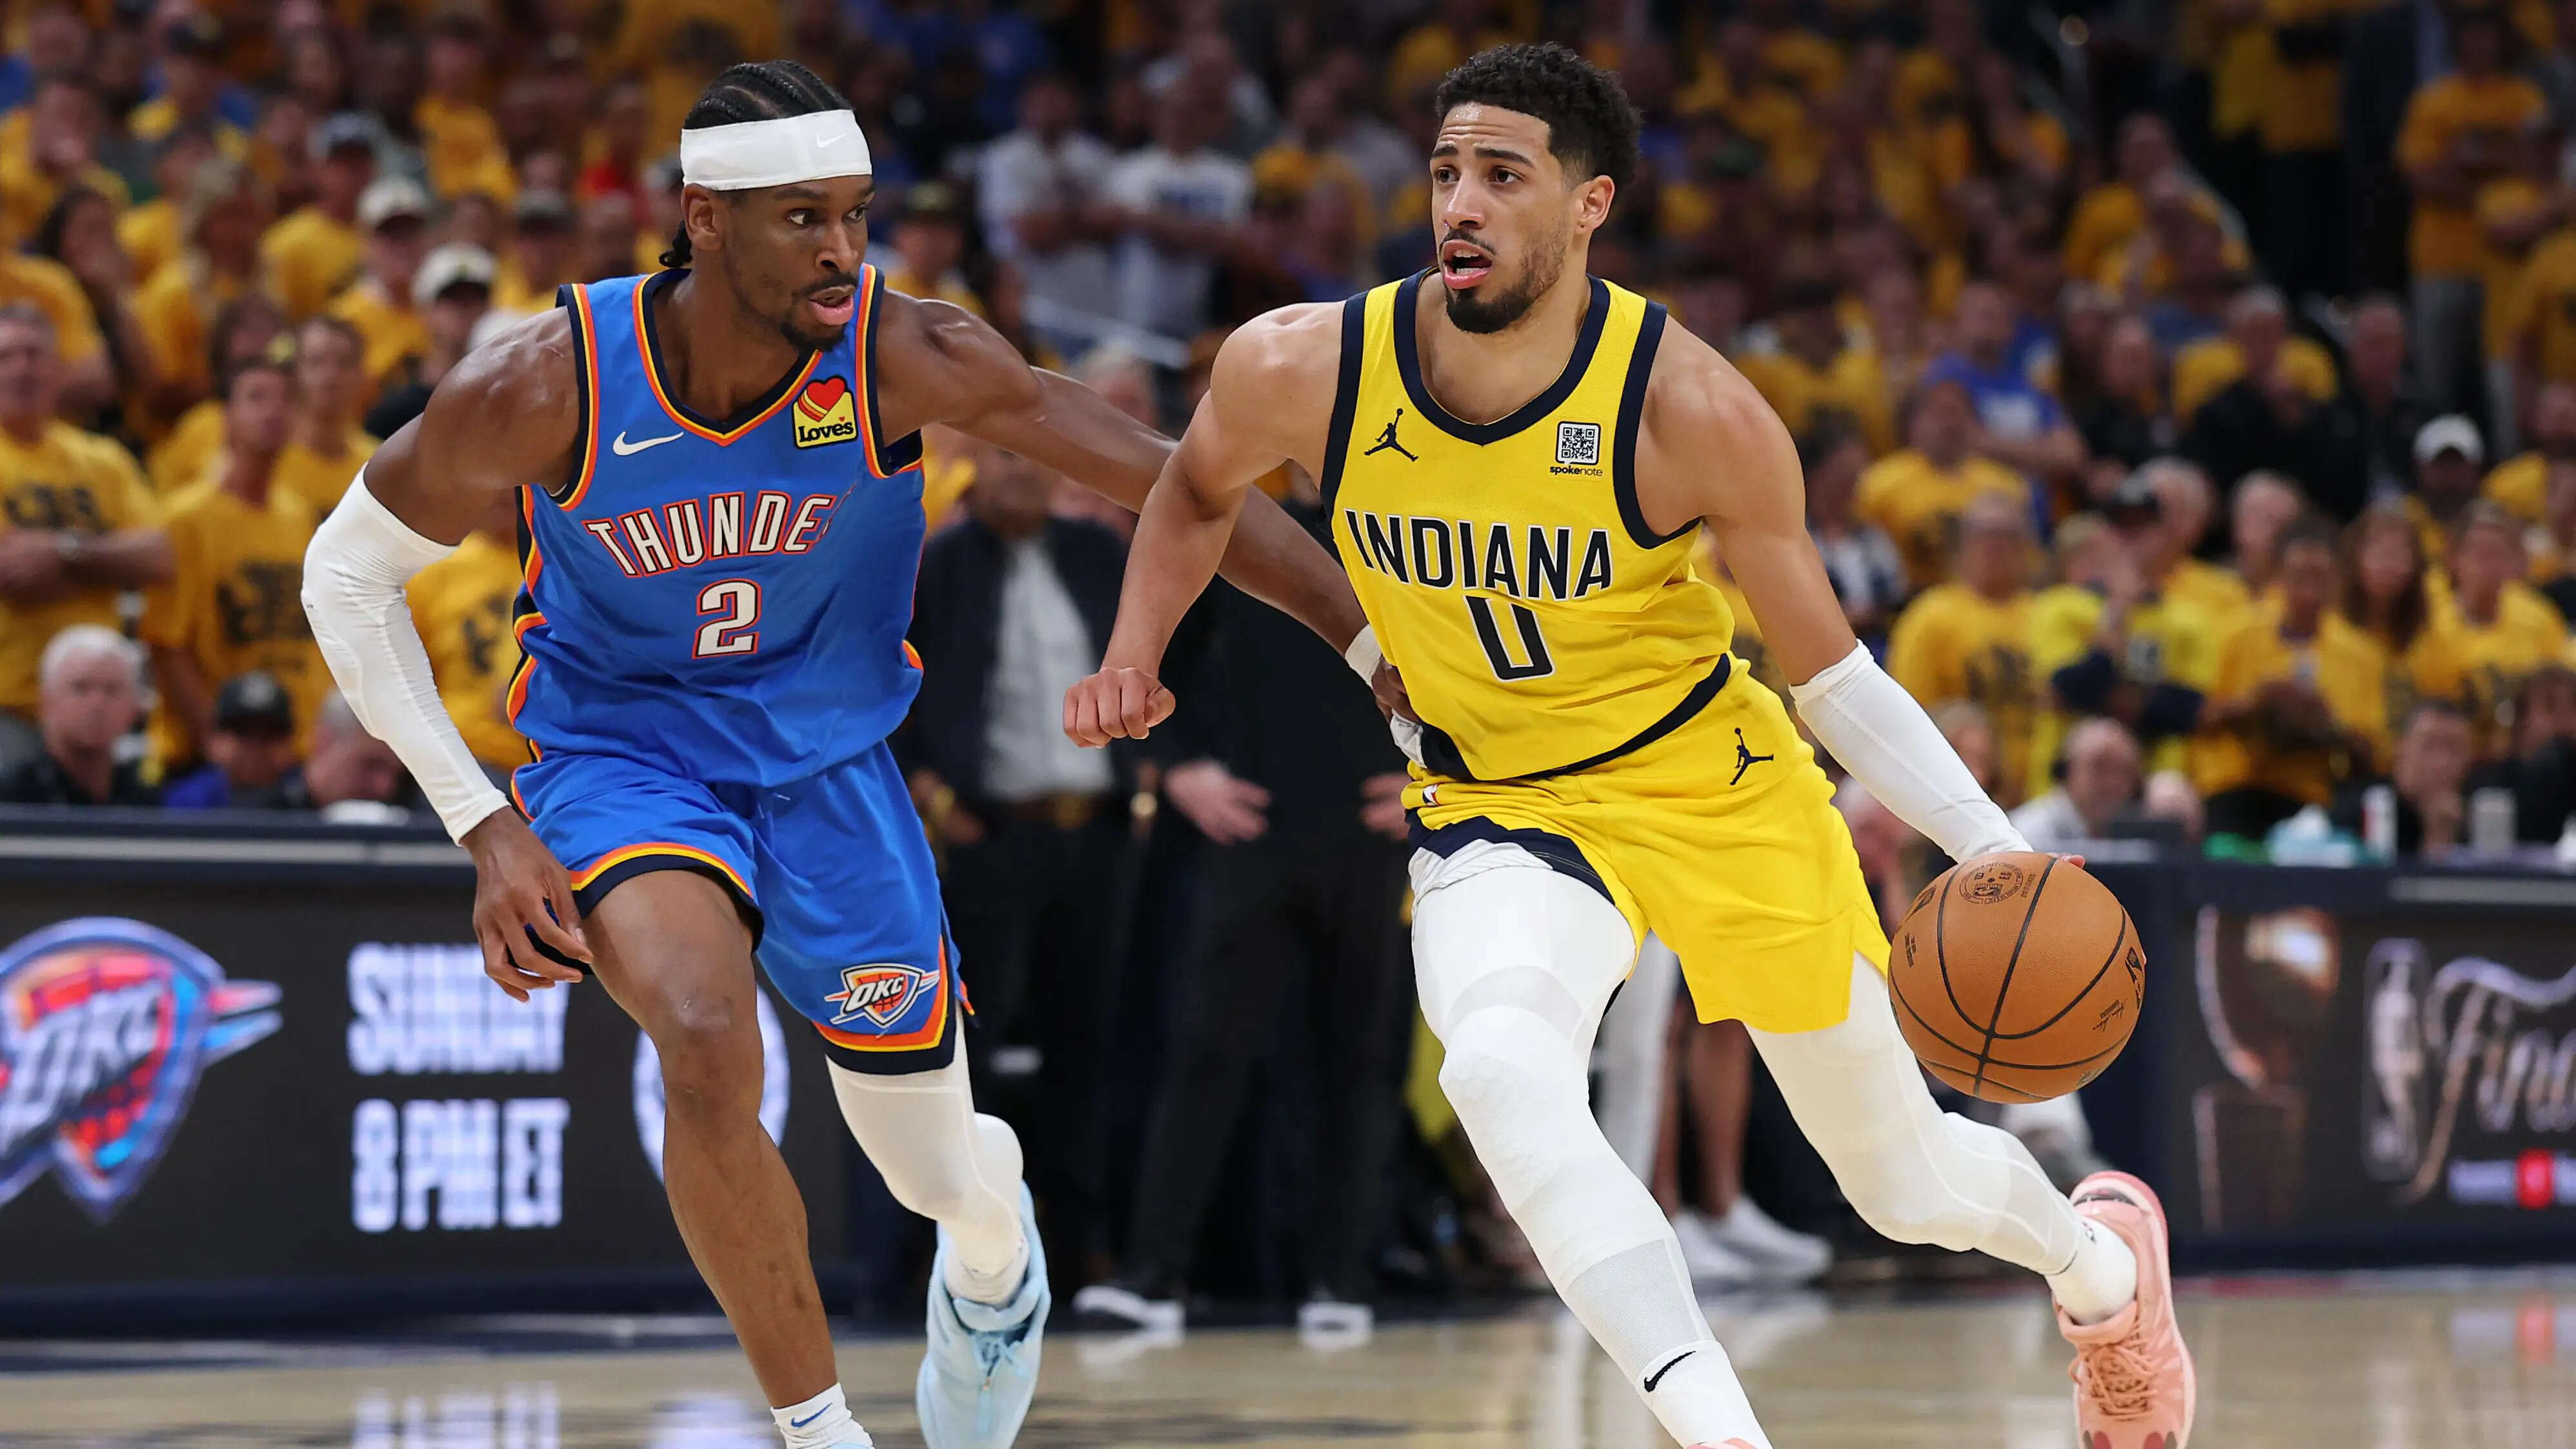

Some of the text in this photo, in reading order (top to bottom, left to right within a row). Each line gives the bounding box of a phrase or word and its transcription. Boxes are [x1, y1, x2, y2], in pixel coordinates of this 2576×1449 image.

[1549, 465, 1603, 476] spokenote
[582, 490, 839, 577] THUNDE
[1343, 507, 1613, 601] INDIANA
[692, 578, 761, 659] 2
[843, 976, 905, 1014] OKC
